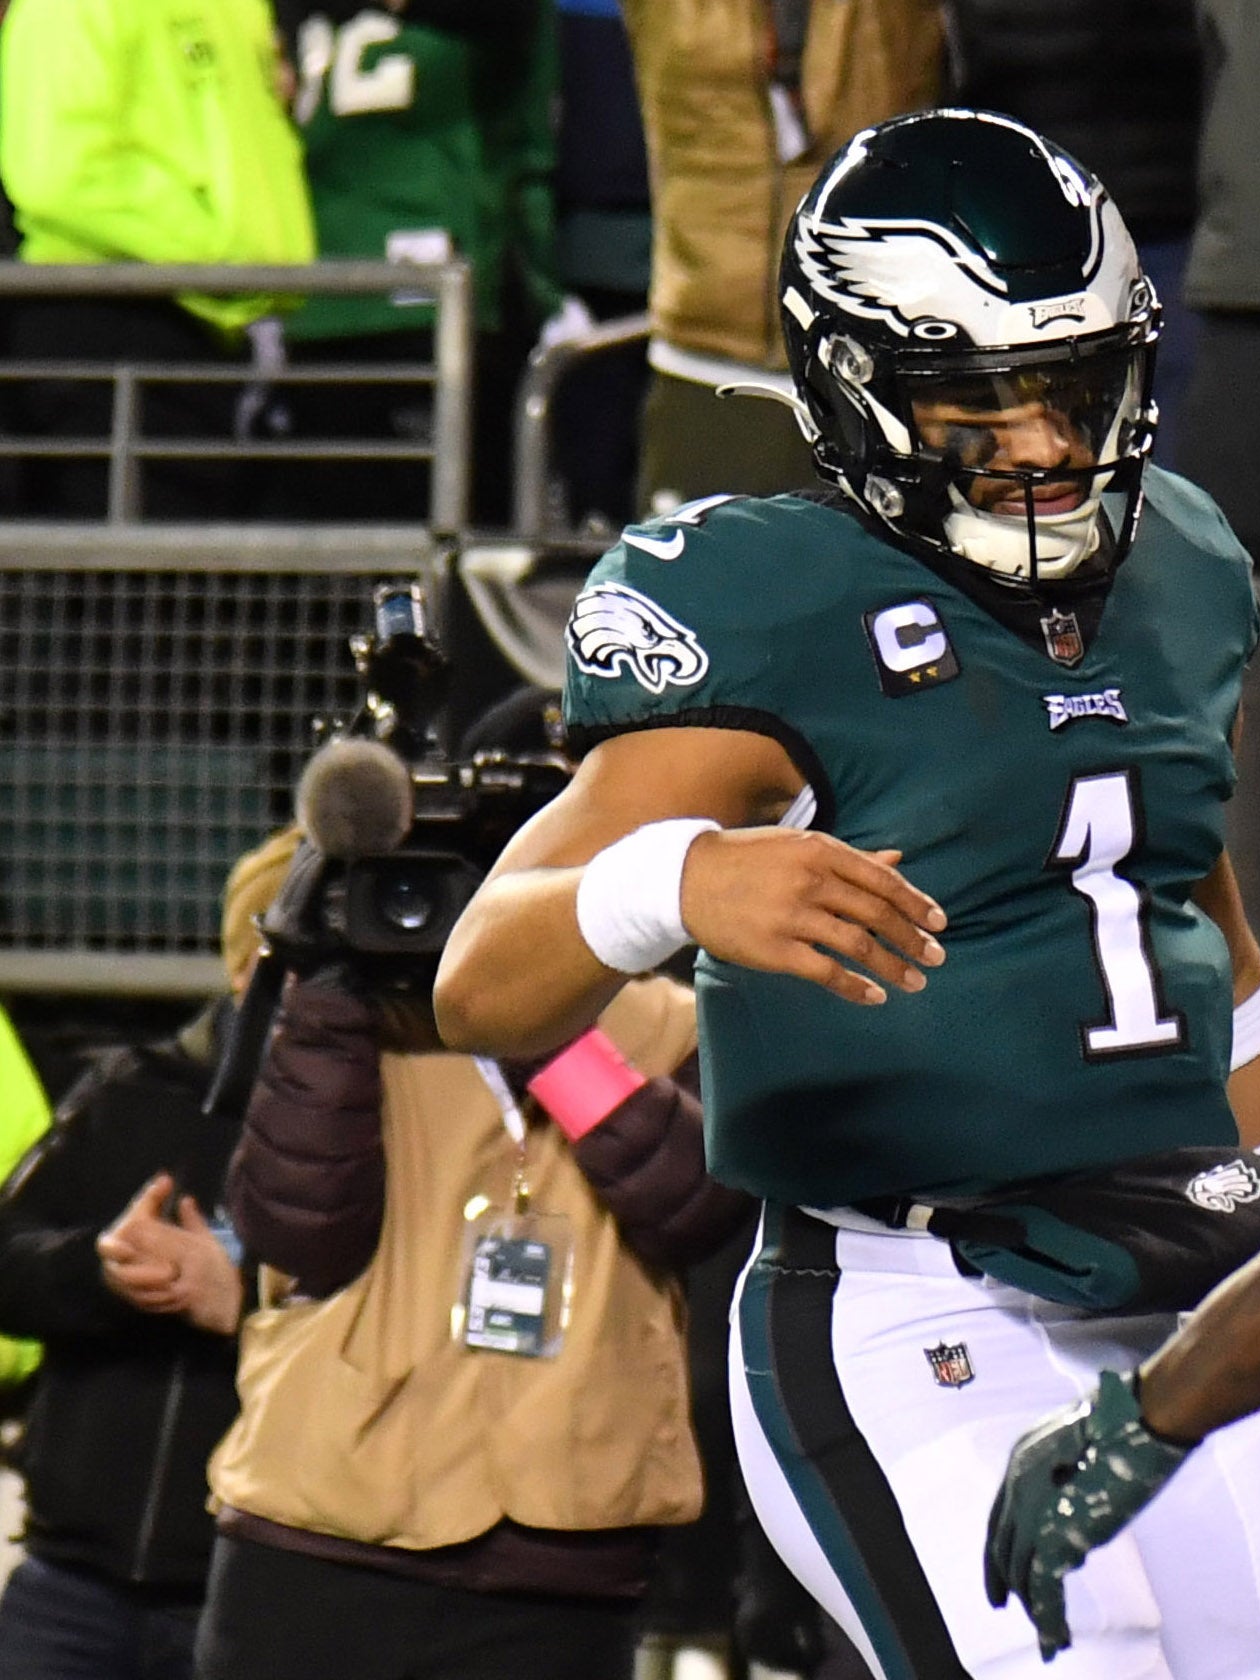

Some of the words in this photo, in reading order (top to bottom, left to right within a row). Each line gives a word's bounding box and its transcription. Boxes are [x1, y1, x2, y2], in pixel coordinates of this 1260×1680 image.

[873, 602, 947, 673] C
[1043, 688, 1129, 731] EAGLES
[1048, 768, 1187, 1060] 1
